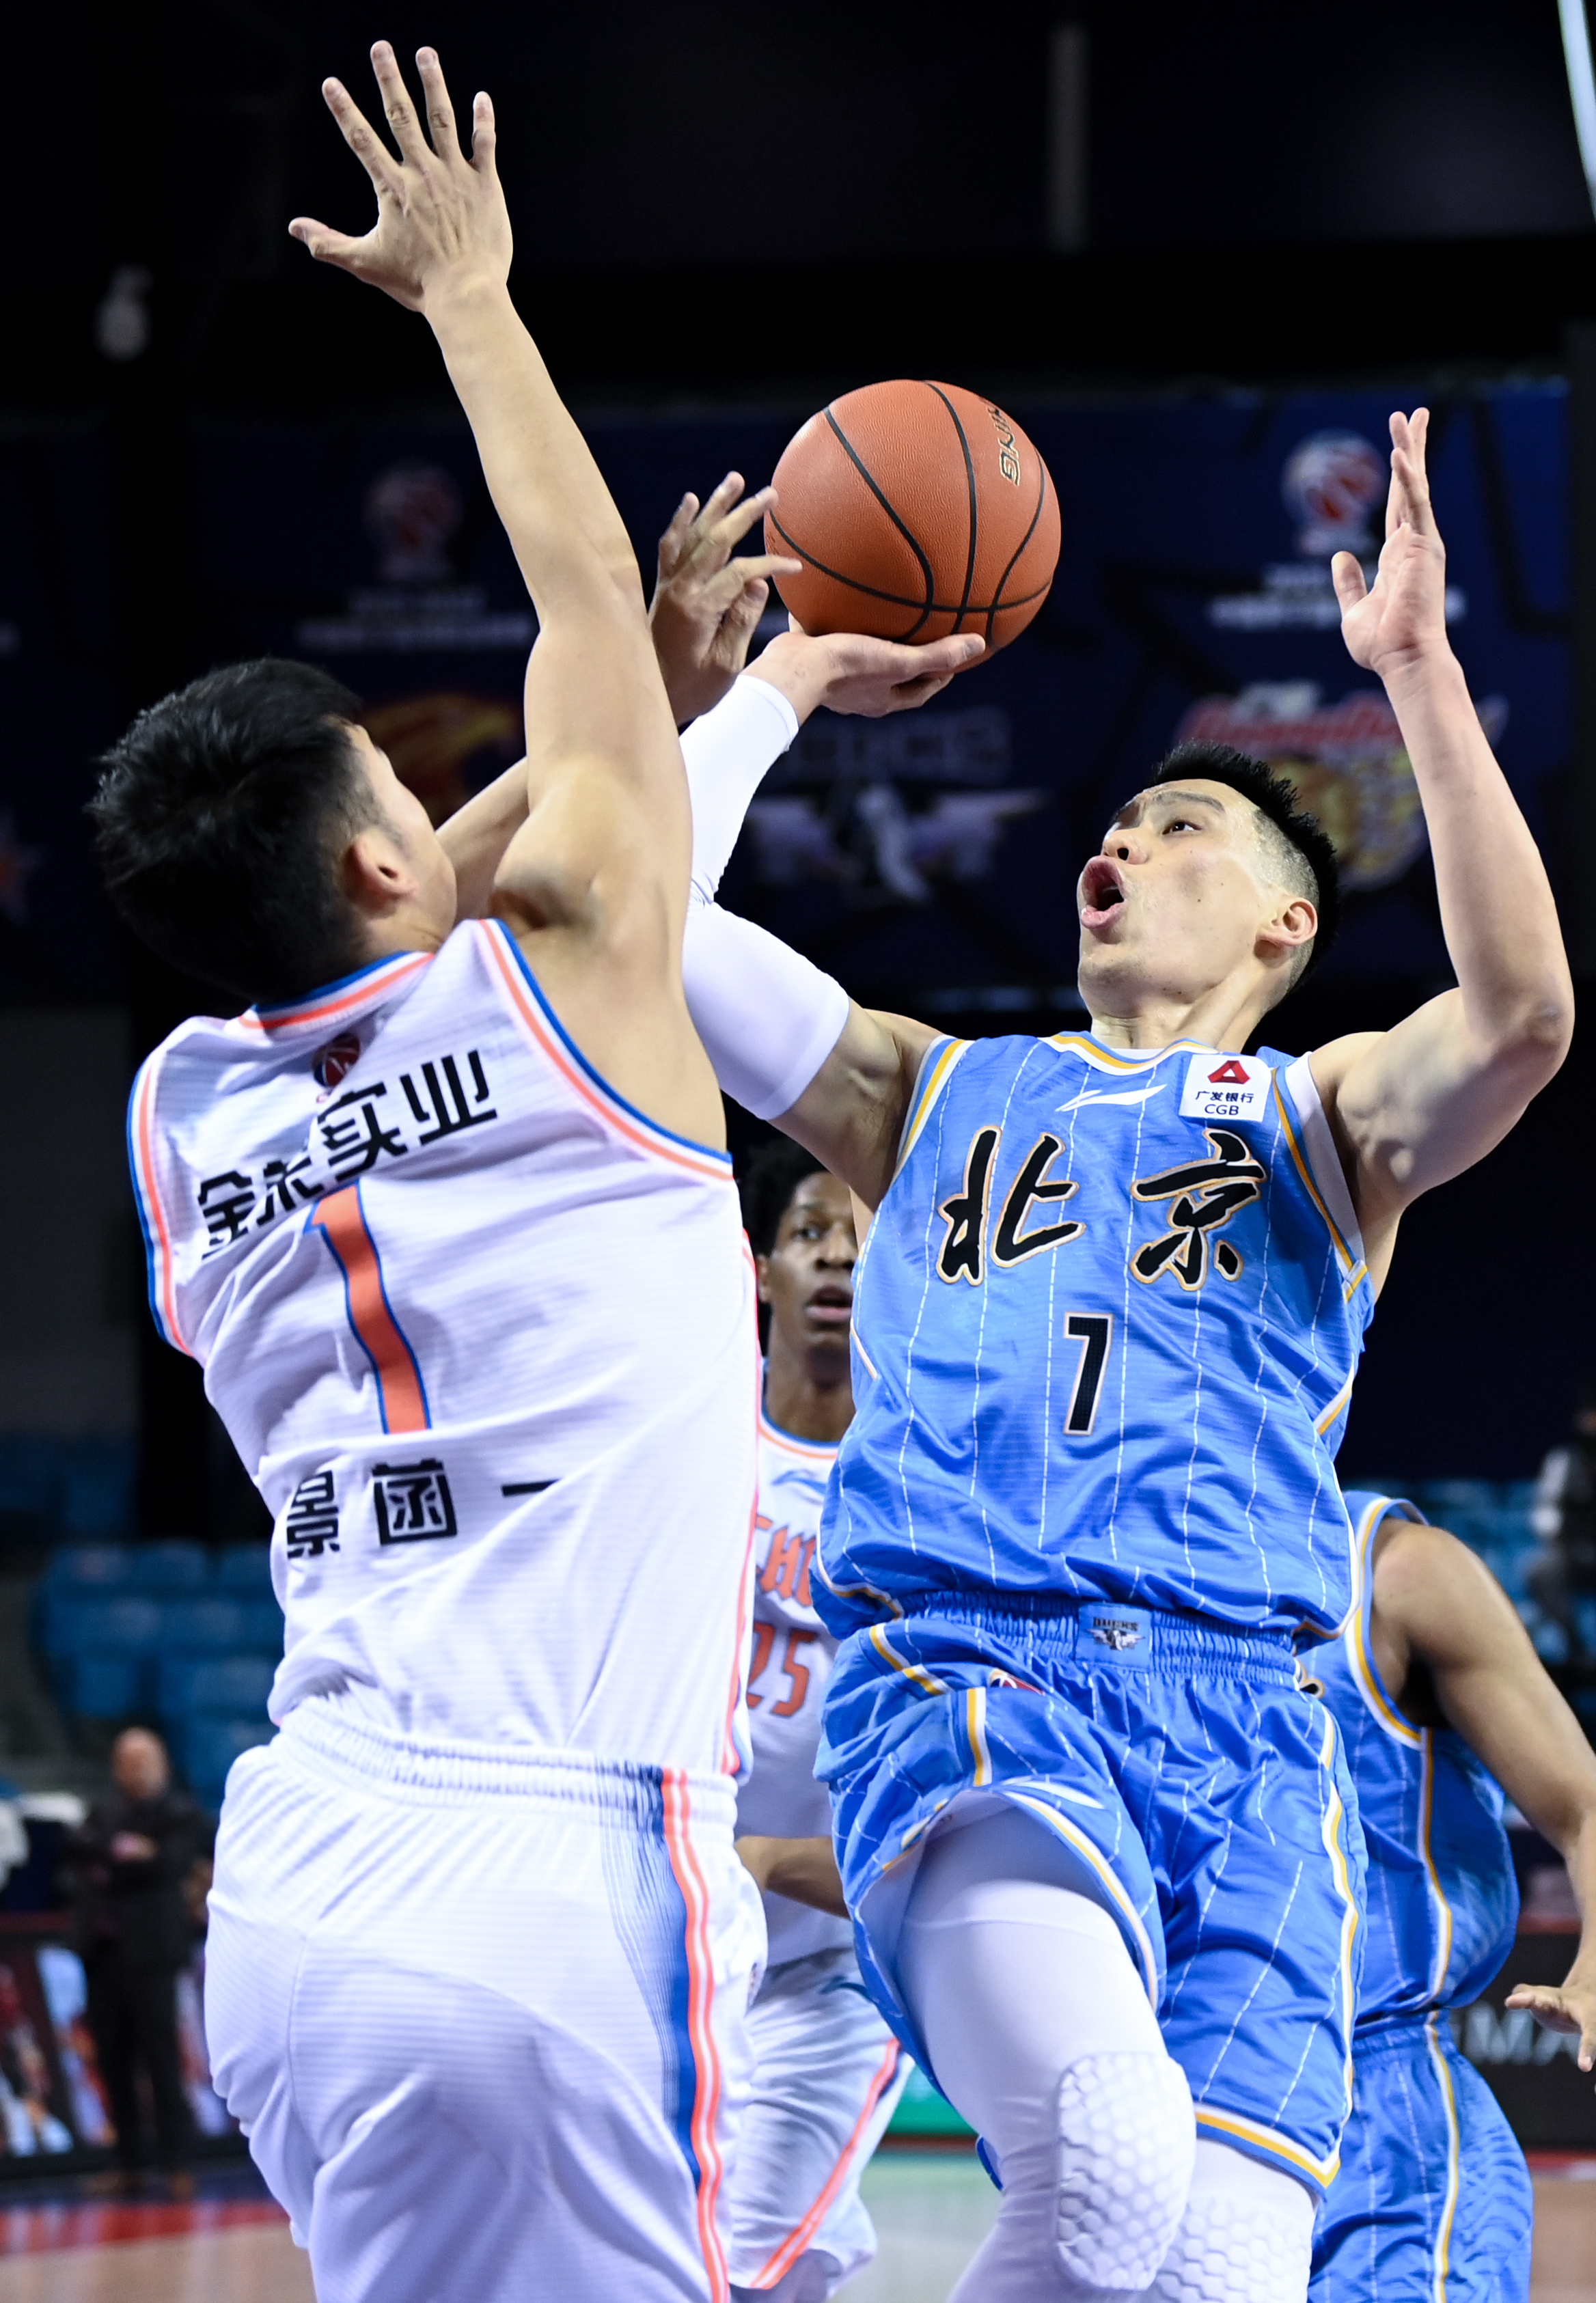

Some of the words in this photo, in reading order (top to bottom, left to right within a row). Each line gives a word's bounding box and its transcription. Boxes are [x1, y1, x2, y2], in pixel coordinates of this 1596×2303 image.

[1195, 1090, 1254, 1103] 广发银行
[1204, 1103, 1239, 1116] CGB
[936, 1125, 1267, 1291] 北京
[1063, 1311, 1114, 1435] 7
